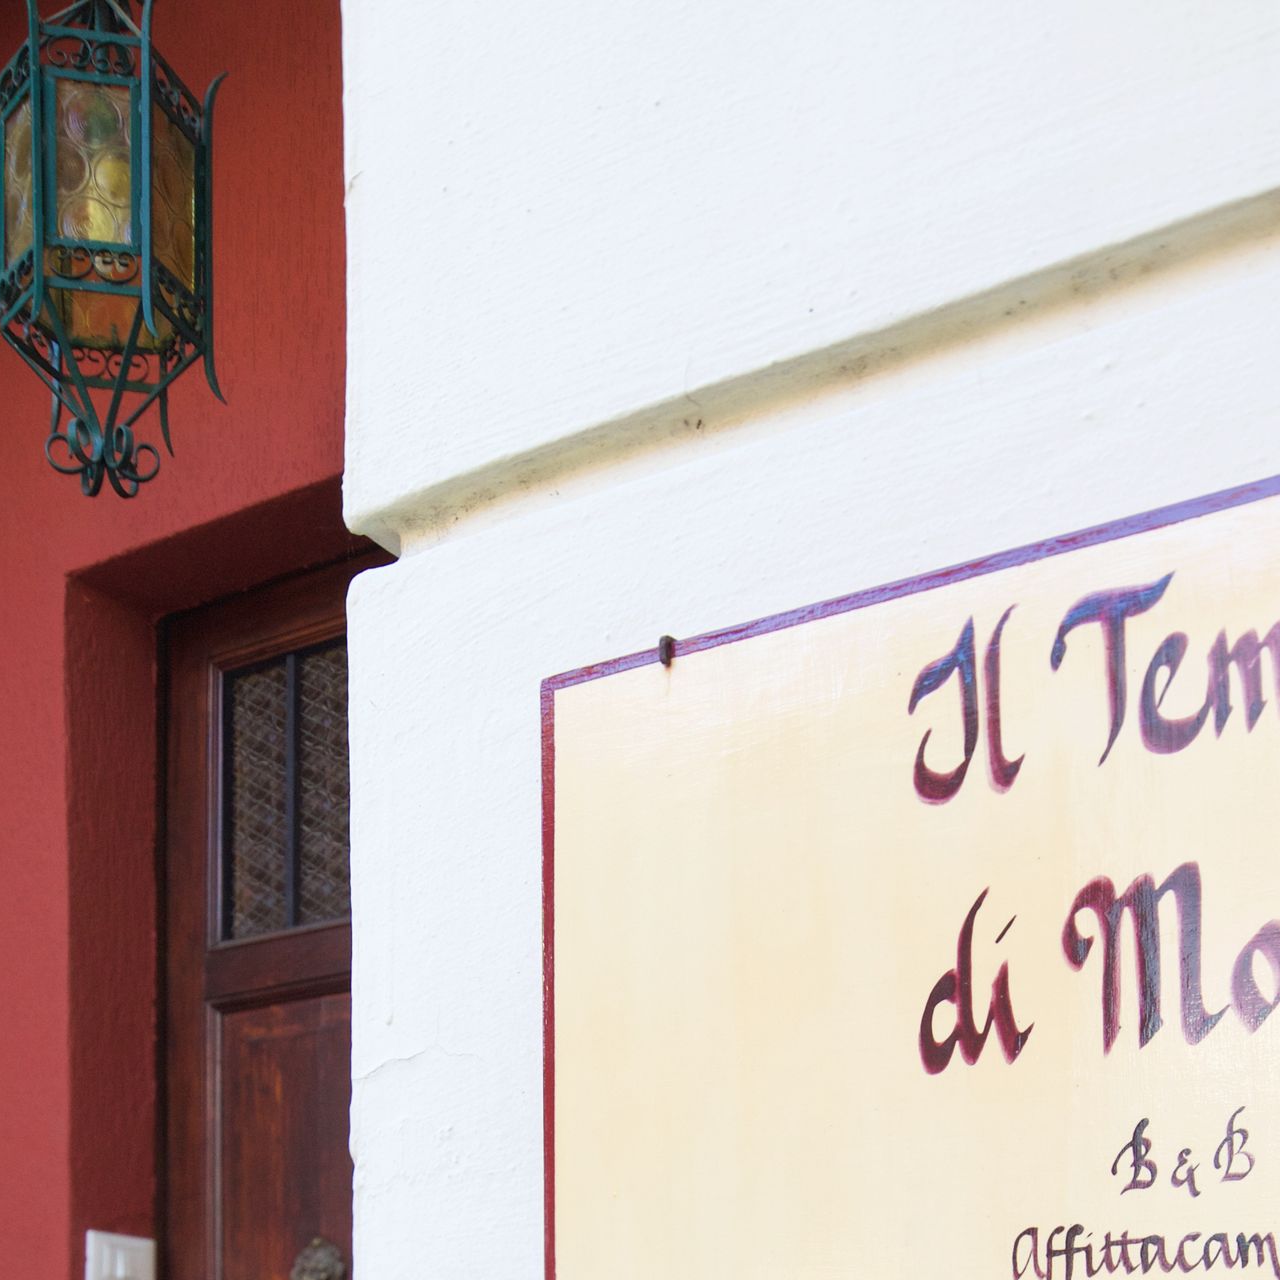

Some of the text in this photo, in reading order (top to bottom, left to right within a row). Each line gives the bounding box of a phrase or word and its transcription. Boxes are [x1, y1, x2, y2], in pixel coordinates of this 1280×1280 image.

[908, 603, 1025, 806] Il
[919, 886, 1035, 1076] di
[1111, 1105, 1255, 1198] B & B
